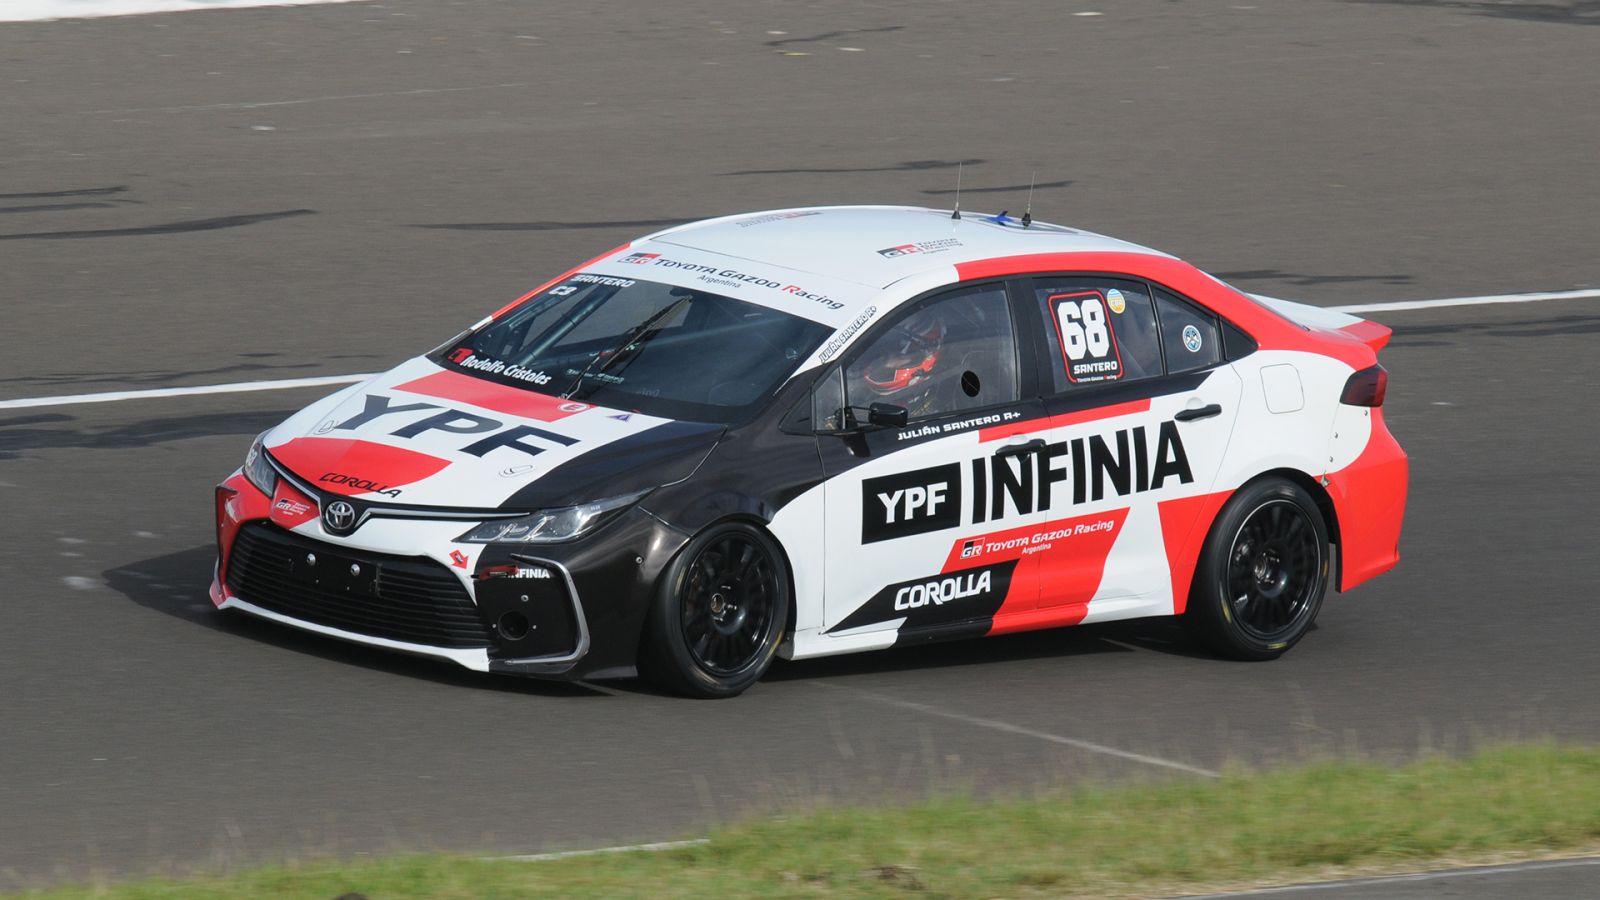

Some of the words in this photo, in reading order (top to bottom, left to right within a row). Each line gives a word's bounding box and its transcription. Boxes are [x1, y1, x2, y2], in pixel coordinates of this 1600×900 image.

[570, 275, 636, 287] SANTERO
[654, 259, 717, 274] TOYOTA
[719, 269, 781, 289] GAZOO
[782, 284, 845, 310] Racing
[696, 274, 742, 289] Argentina
[838, 312, 869, 344] SANTERO
[1057, 299, 1110, 360] 68
[460, 354, 506, 373] Rodolfo
[503, 364, 552, 385] Cristales
[1073, 360, 1118, 375] SANTERO
[333, 394, 582, 458] YPF
[897, 425, 941, 441] JULIÁN
[943, 414, 1001, 432] SANTERO
[1003, 411, 1021, 421] R+
[319, 472, 402, 499] COROLLA
[877, 481, 948, 525] YPF
[972, 420, 1194, 524] INFINIA
[962, 544, 983, 558] GR
[986, 537, 1029, 553] TOYOTA
[1031, 529, 1072, 544] GAZOO
[1074, 519, 1115, 535] Racing
[1021, 543, 1052, 556] Argentina
[894, 570, 991, 612] COROLLA
